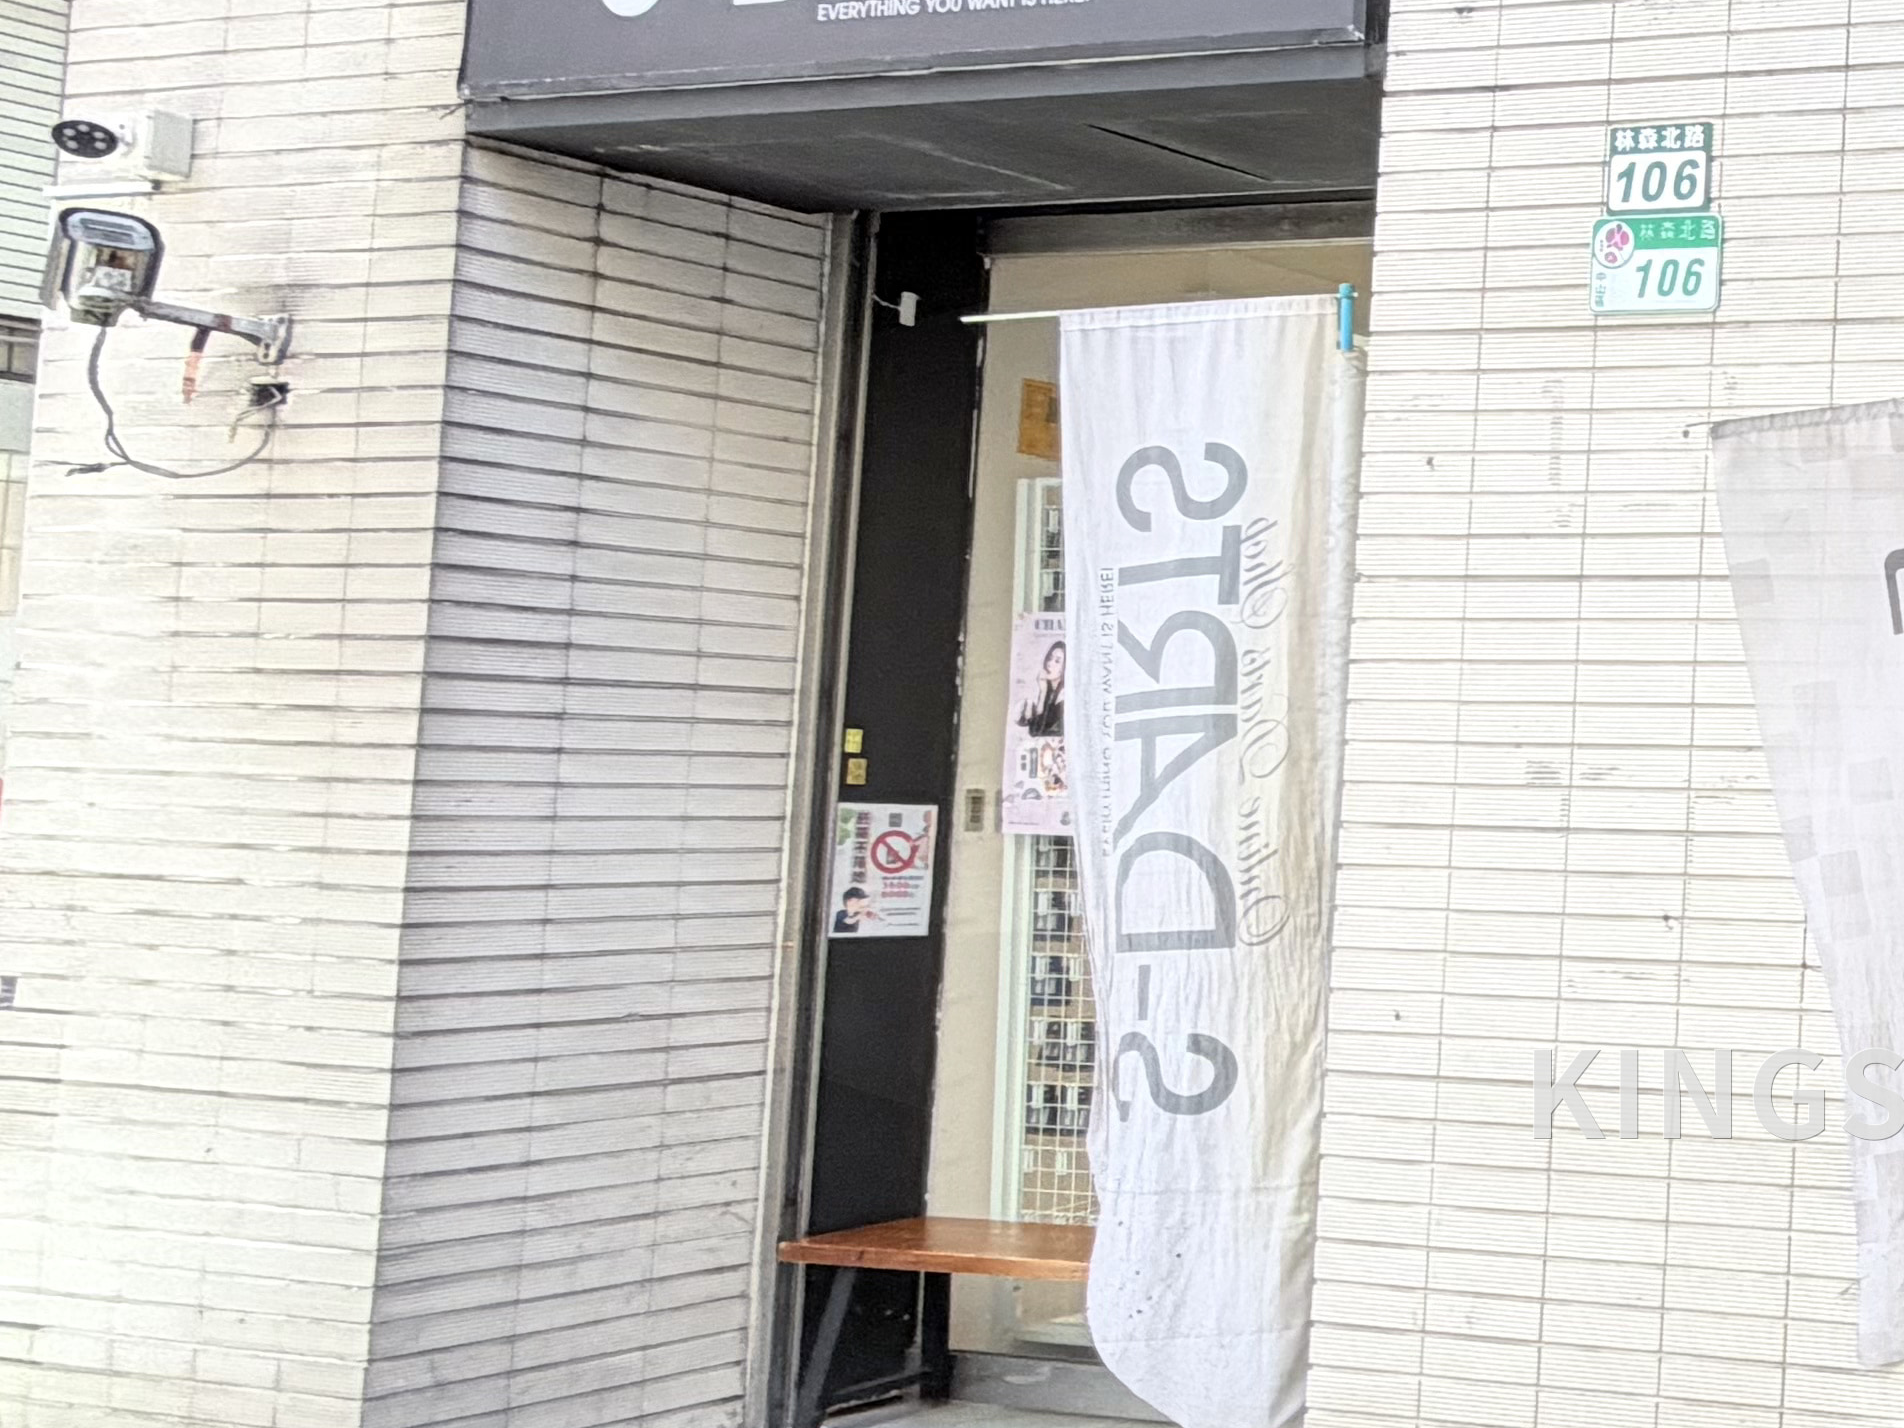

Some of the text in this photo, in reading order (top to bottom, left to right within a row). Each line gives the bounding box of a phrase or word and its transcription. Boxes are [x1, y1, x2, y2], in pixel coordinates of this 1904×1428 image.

[1614, 124, 1705, 151] 林森北路
[1616, 158, 1701, 203] 106
[1635, 258, 1706, 299] 106
